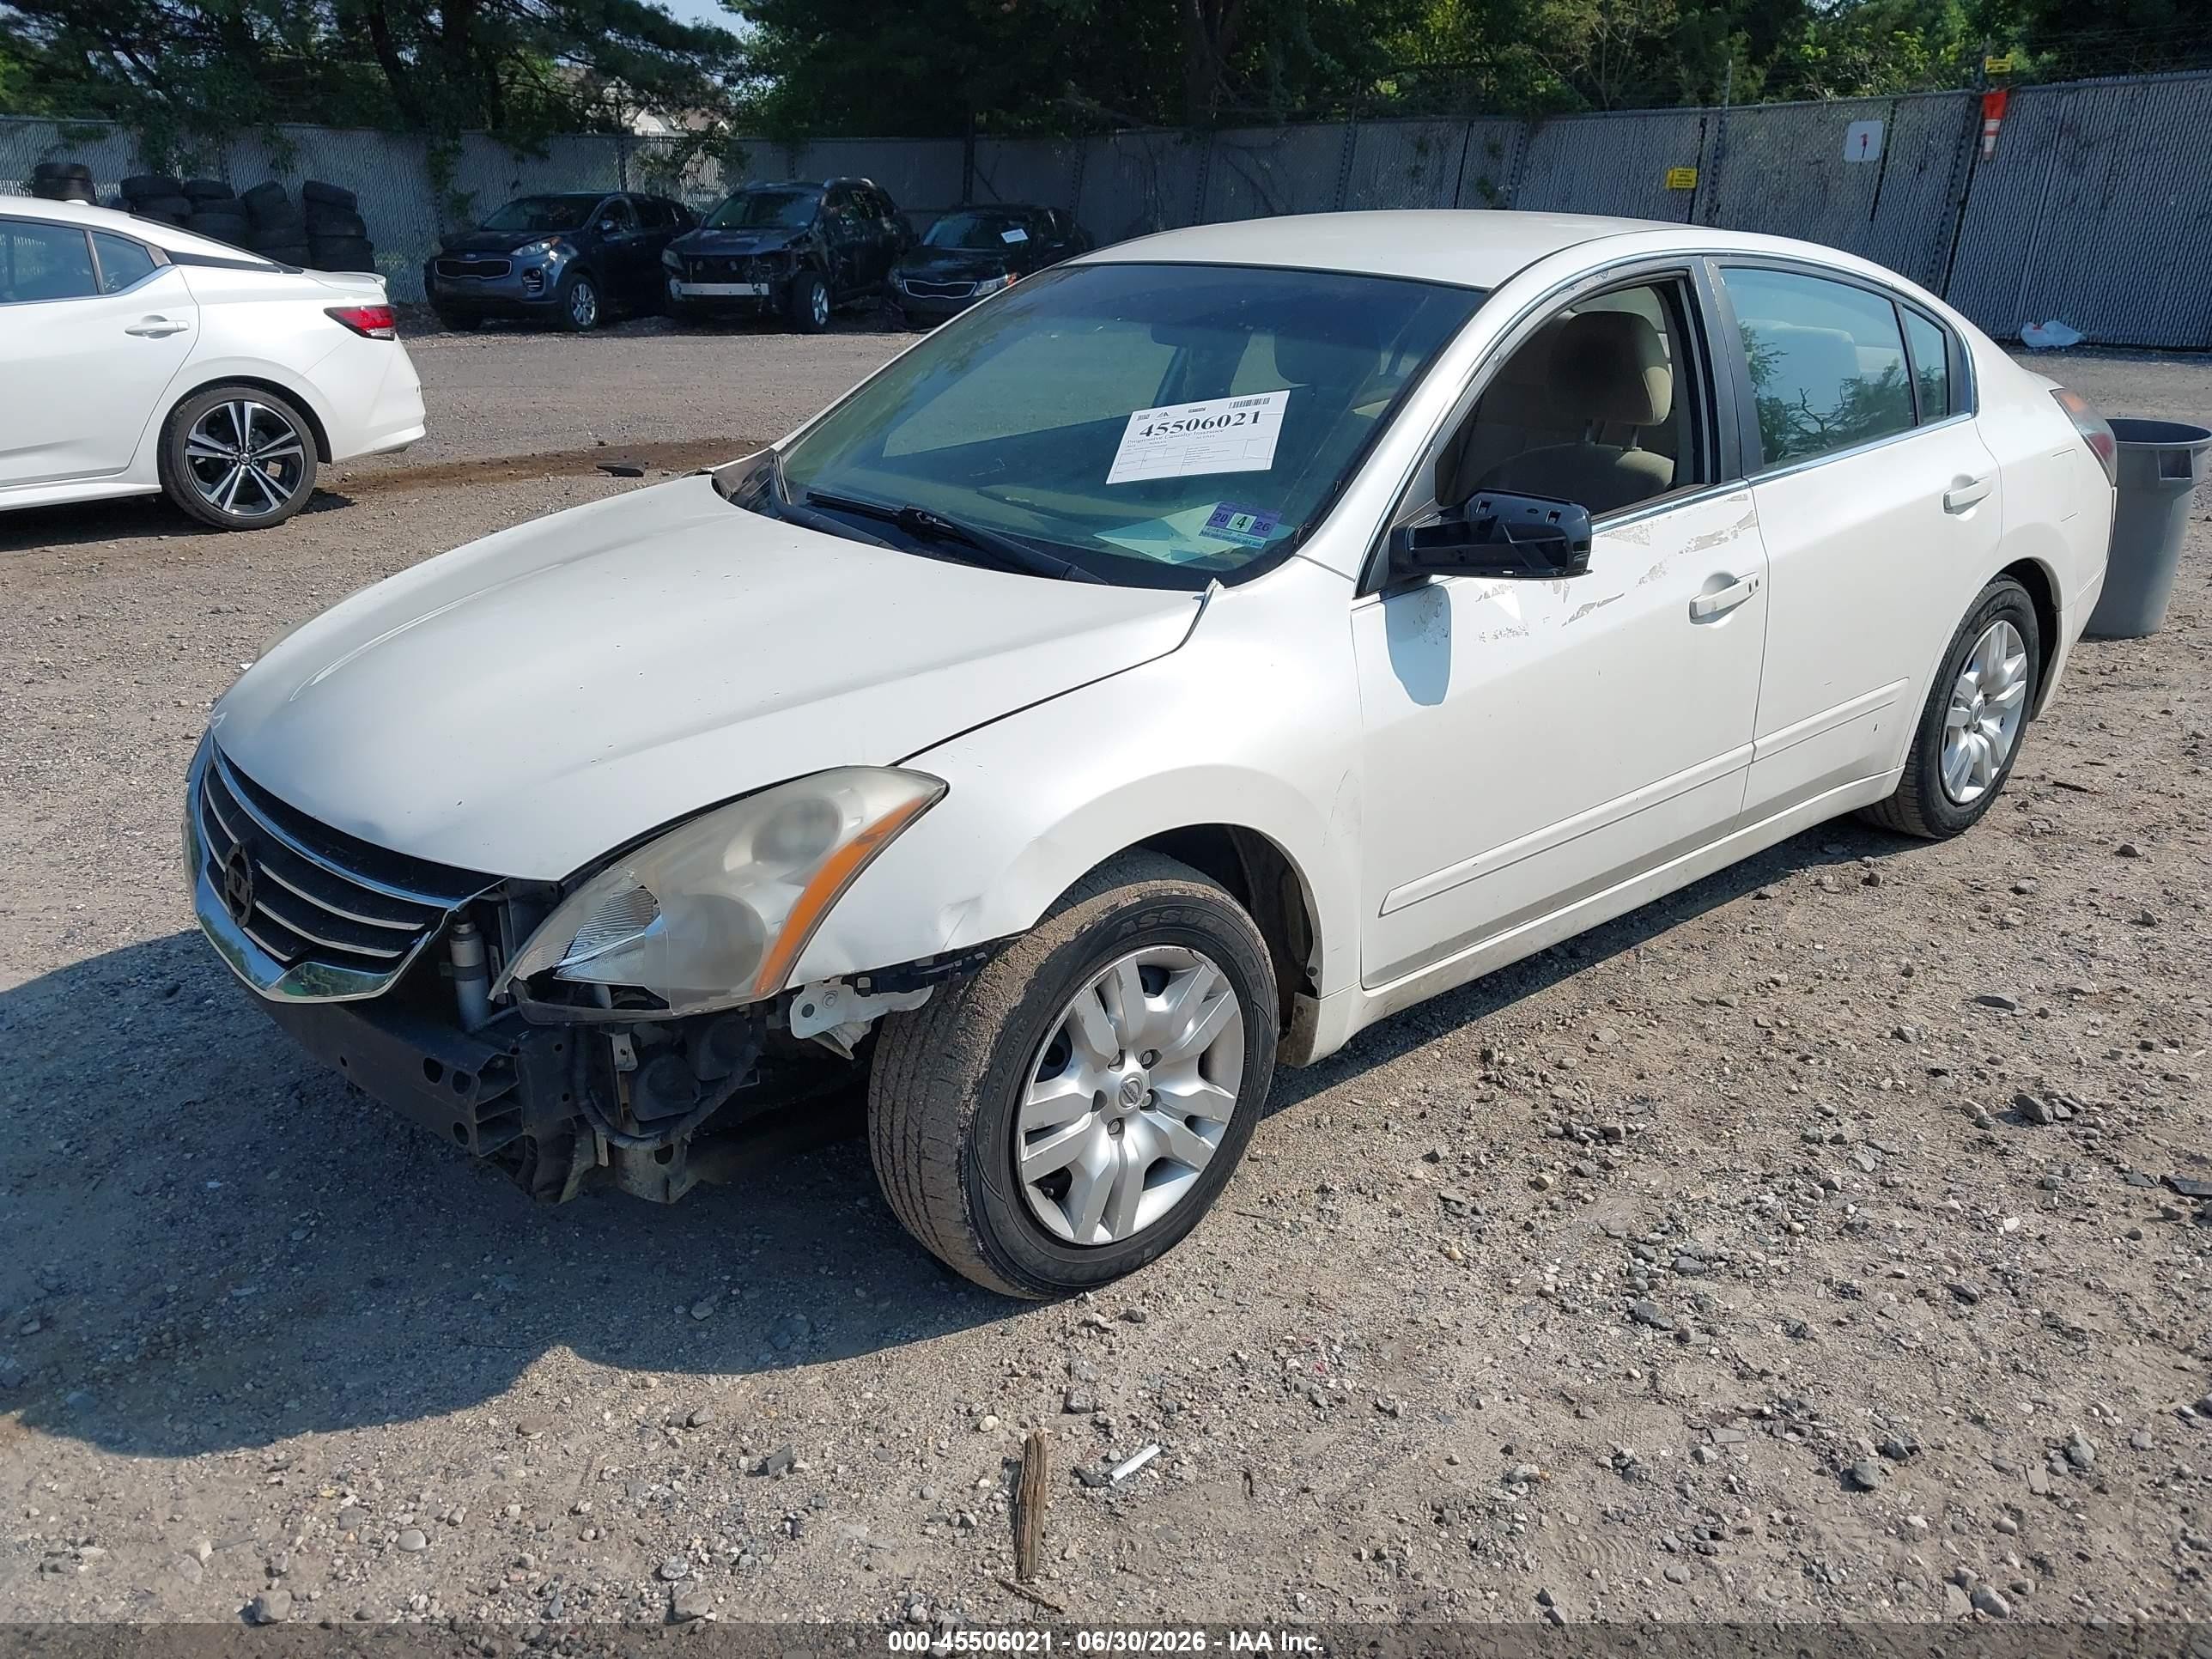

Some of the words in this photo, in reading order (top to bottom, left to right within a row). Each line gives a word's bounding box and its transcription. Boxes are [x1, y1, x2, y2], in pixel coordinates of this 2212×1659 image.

[1139, 410, 1261, 437] 45506021
[1212, 513, 1229, 523] 20
[1237, 515, 1248, 529] 4
[1254, 521, 1271, 532] 26
